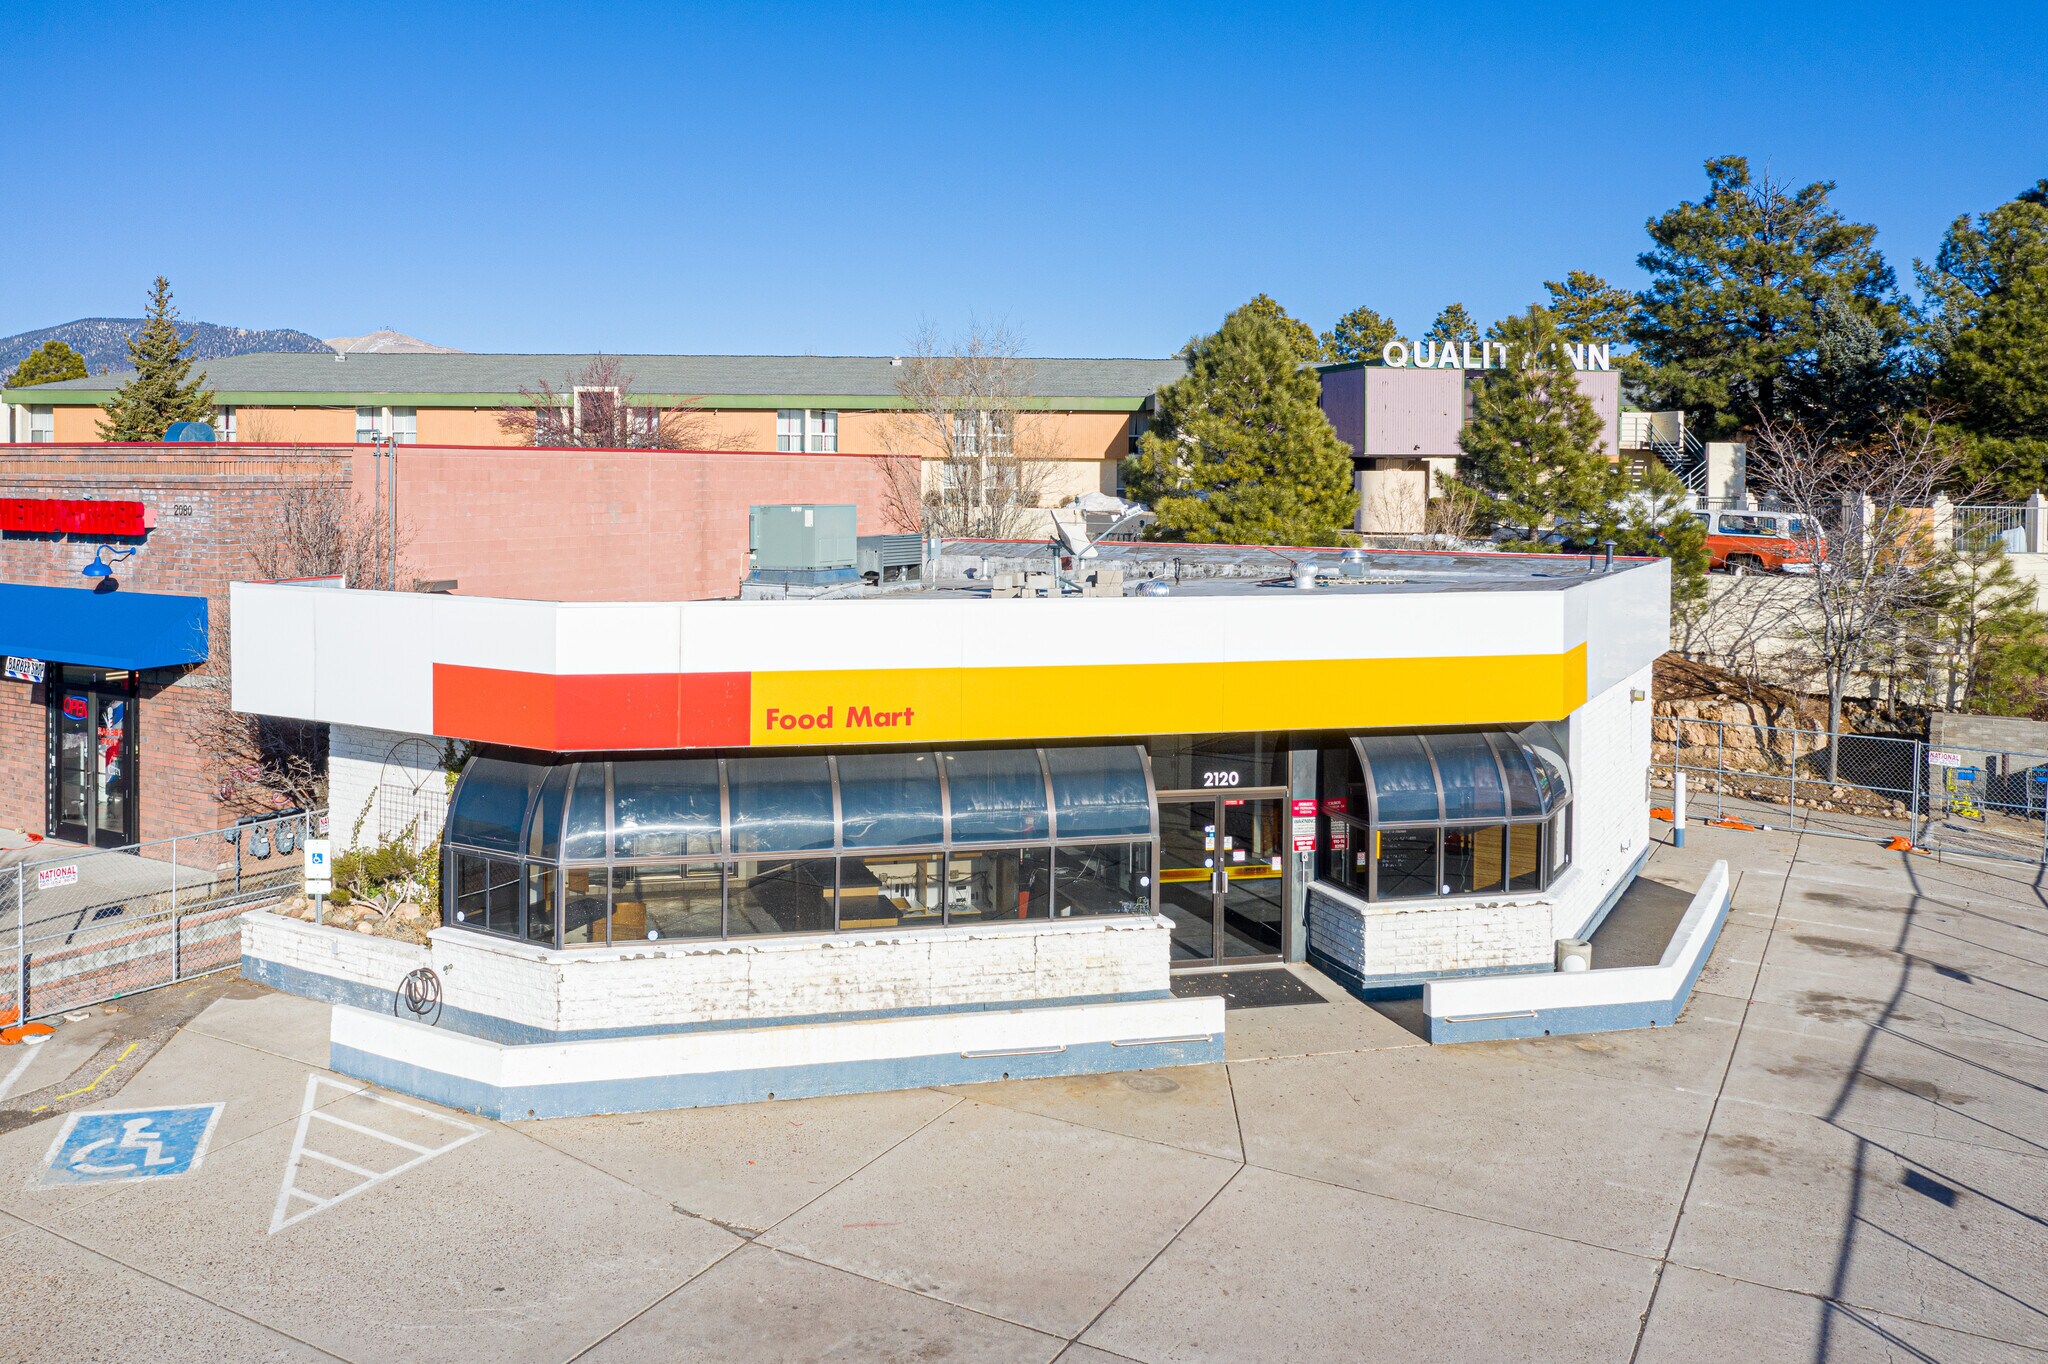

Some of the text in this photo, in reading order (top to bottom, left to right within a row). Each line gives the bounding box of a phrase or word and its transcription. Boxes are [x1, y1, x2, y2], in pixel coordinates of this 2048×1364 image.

[173, 504, 193, 517] 2080
[9, 657, 45, 677] BARBER SHOP
[63, 697, 88, 718] OPEN
[766, 705, 915, 731] Food Mart
[1930, 752, 1960, 761] NATIONAL
[1203, 771, 1239, 787] 2120
[39, 866, 77, 880] NATIONAL
